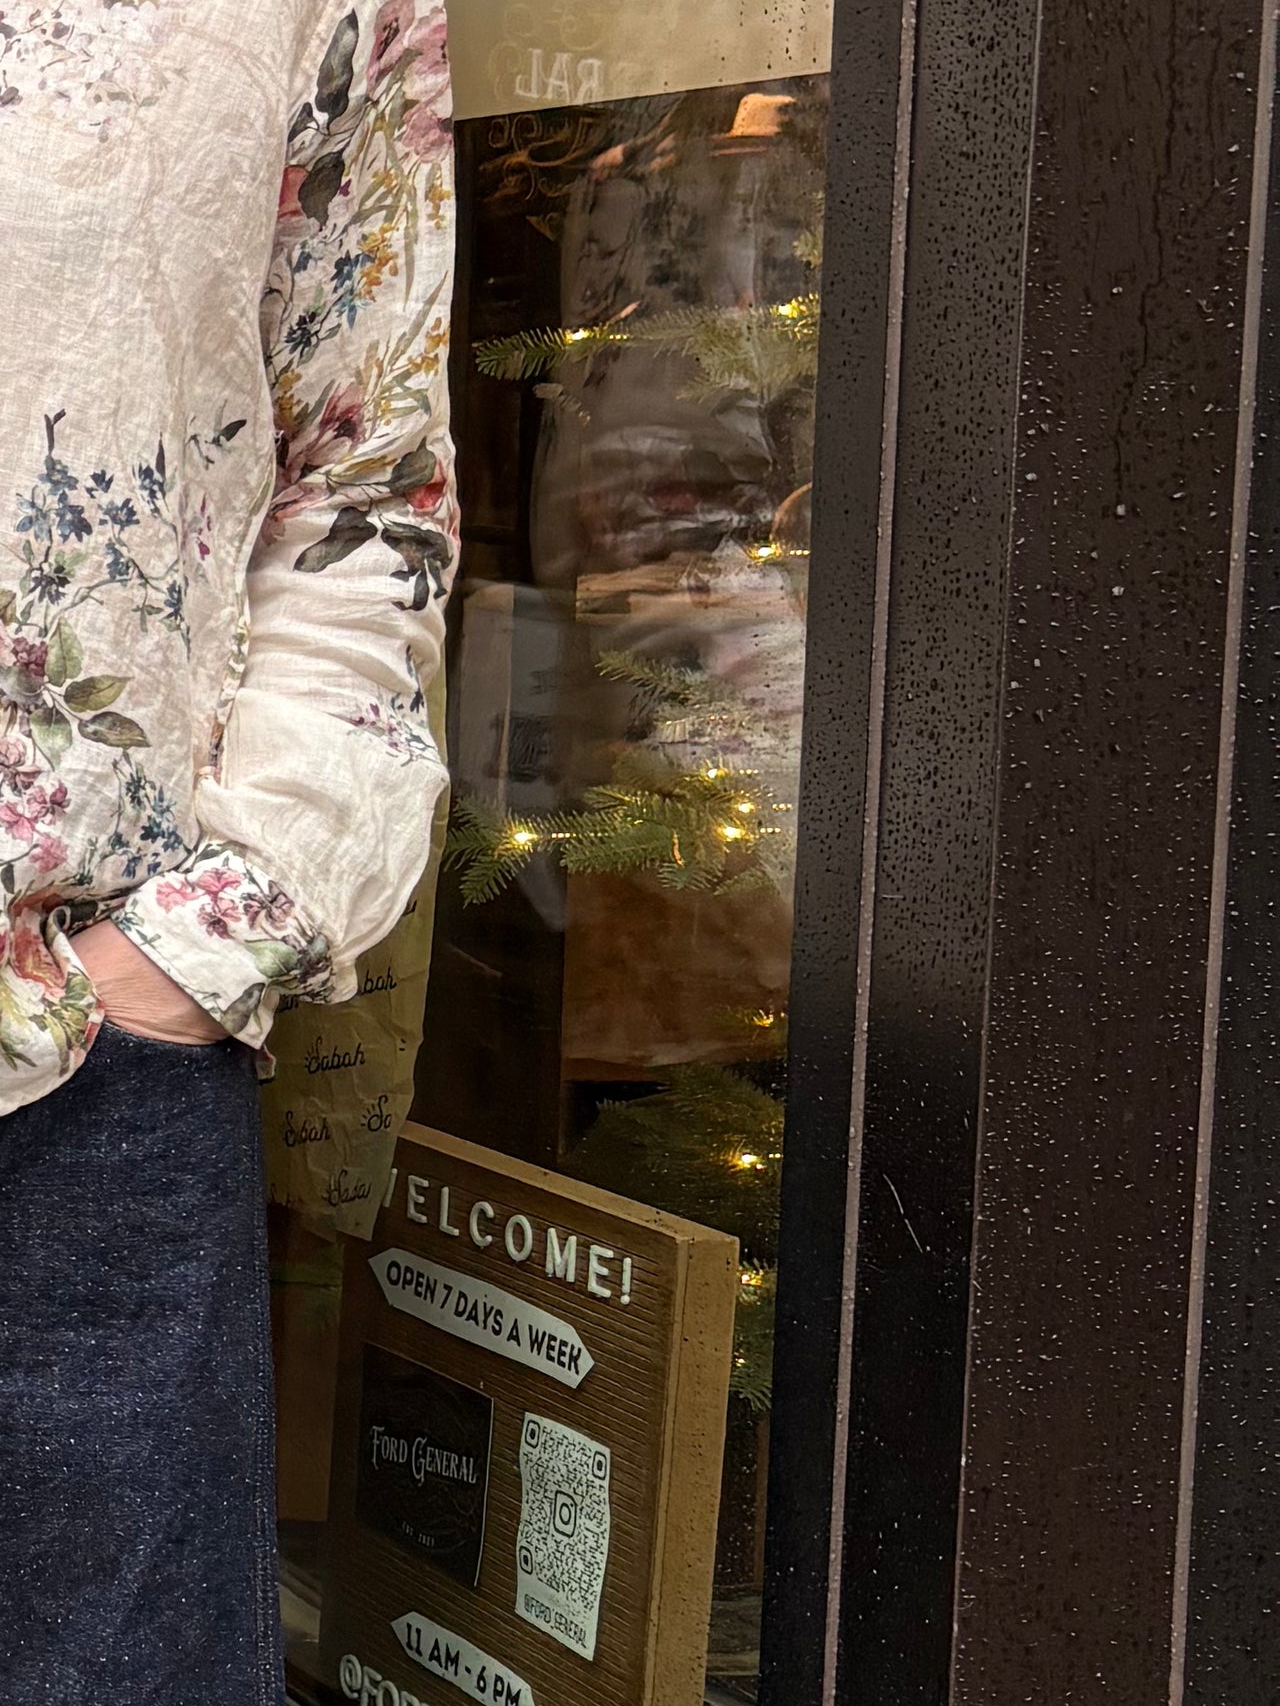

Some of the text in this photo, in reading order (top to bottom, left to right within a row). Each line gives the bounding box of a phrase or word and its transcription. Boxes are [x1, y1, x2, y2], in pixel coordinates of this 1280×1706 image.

[306, 1036, 366, 1075] Sabah
[286, 1110, 331, 1148] Sbah
[386, 1259, 582, 1376] OPEN 7 DAYS A WEEK
[405, 1622, 423, 1657] 11
[428, 1638, 460, 1677] AM
[476, 1665, 487, 1694] 6
